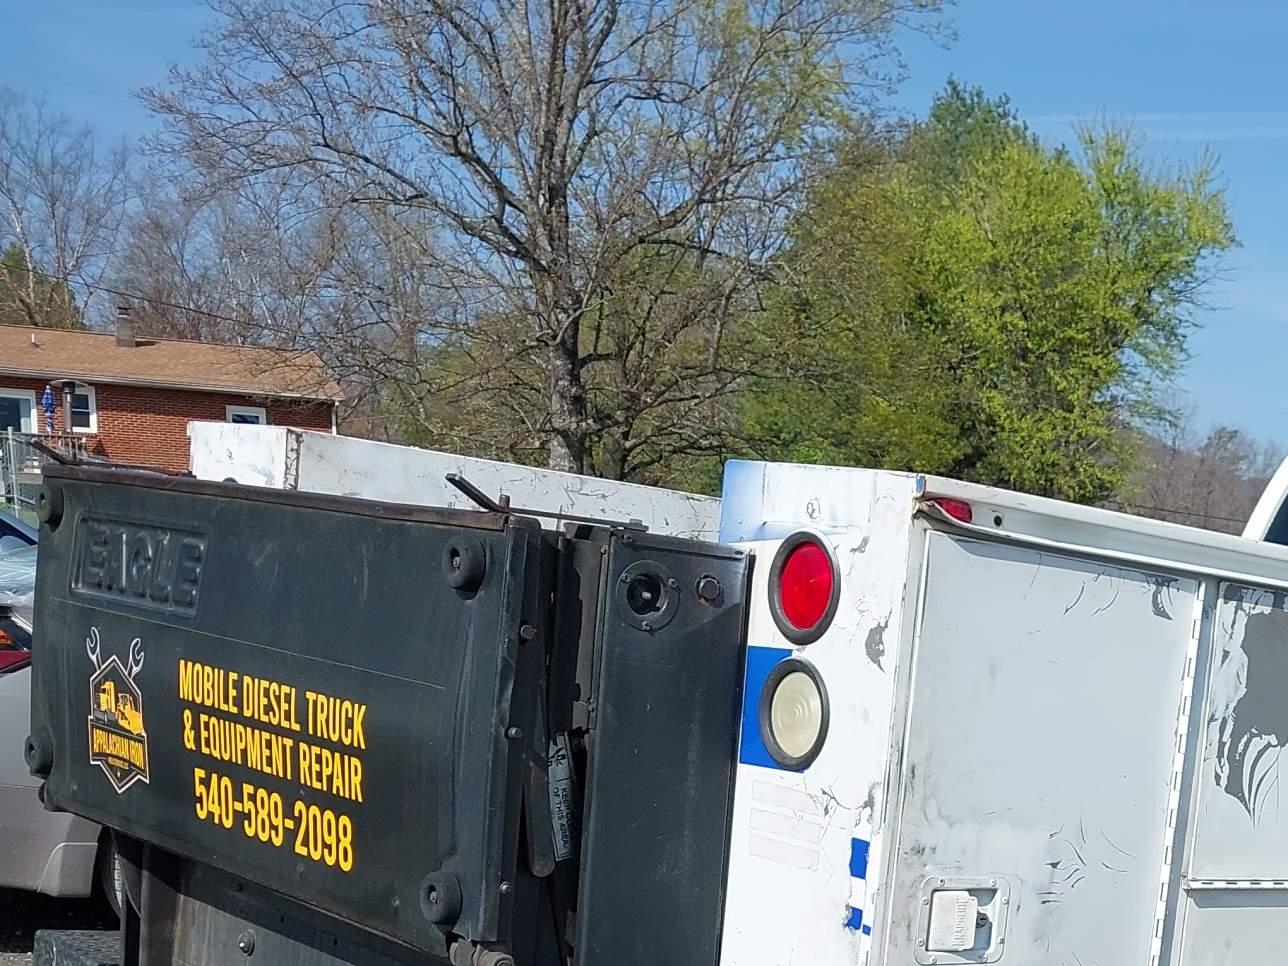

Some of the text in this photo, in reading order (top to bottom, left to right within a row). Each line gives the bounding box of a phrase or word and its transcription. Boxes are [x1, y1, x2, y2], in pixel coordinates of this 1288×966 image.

[178, 659, 367, 750] MOBILE DIESEL TRUCK
[183, 709, 363, 803] & EQUIPMENT REPAIR
[193, 767, 354, 873] 540-589-2098
[555, 801, 565, 821] THIS
